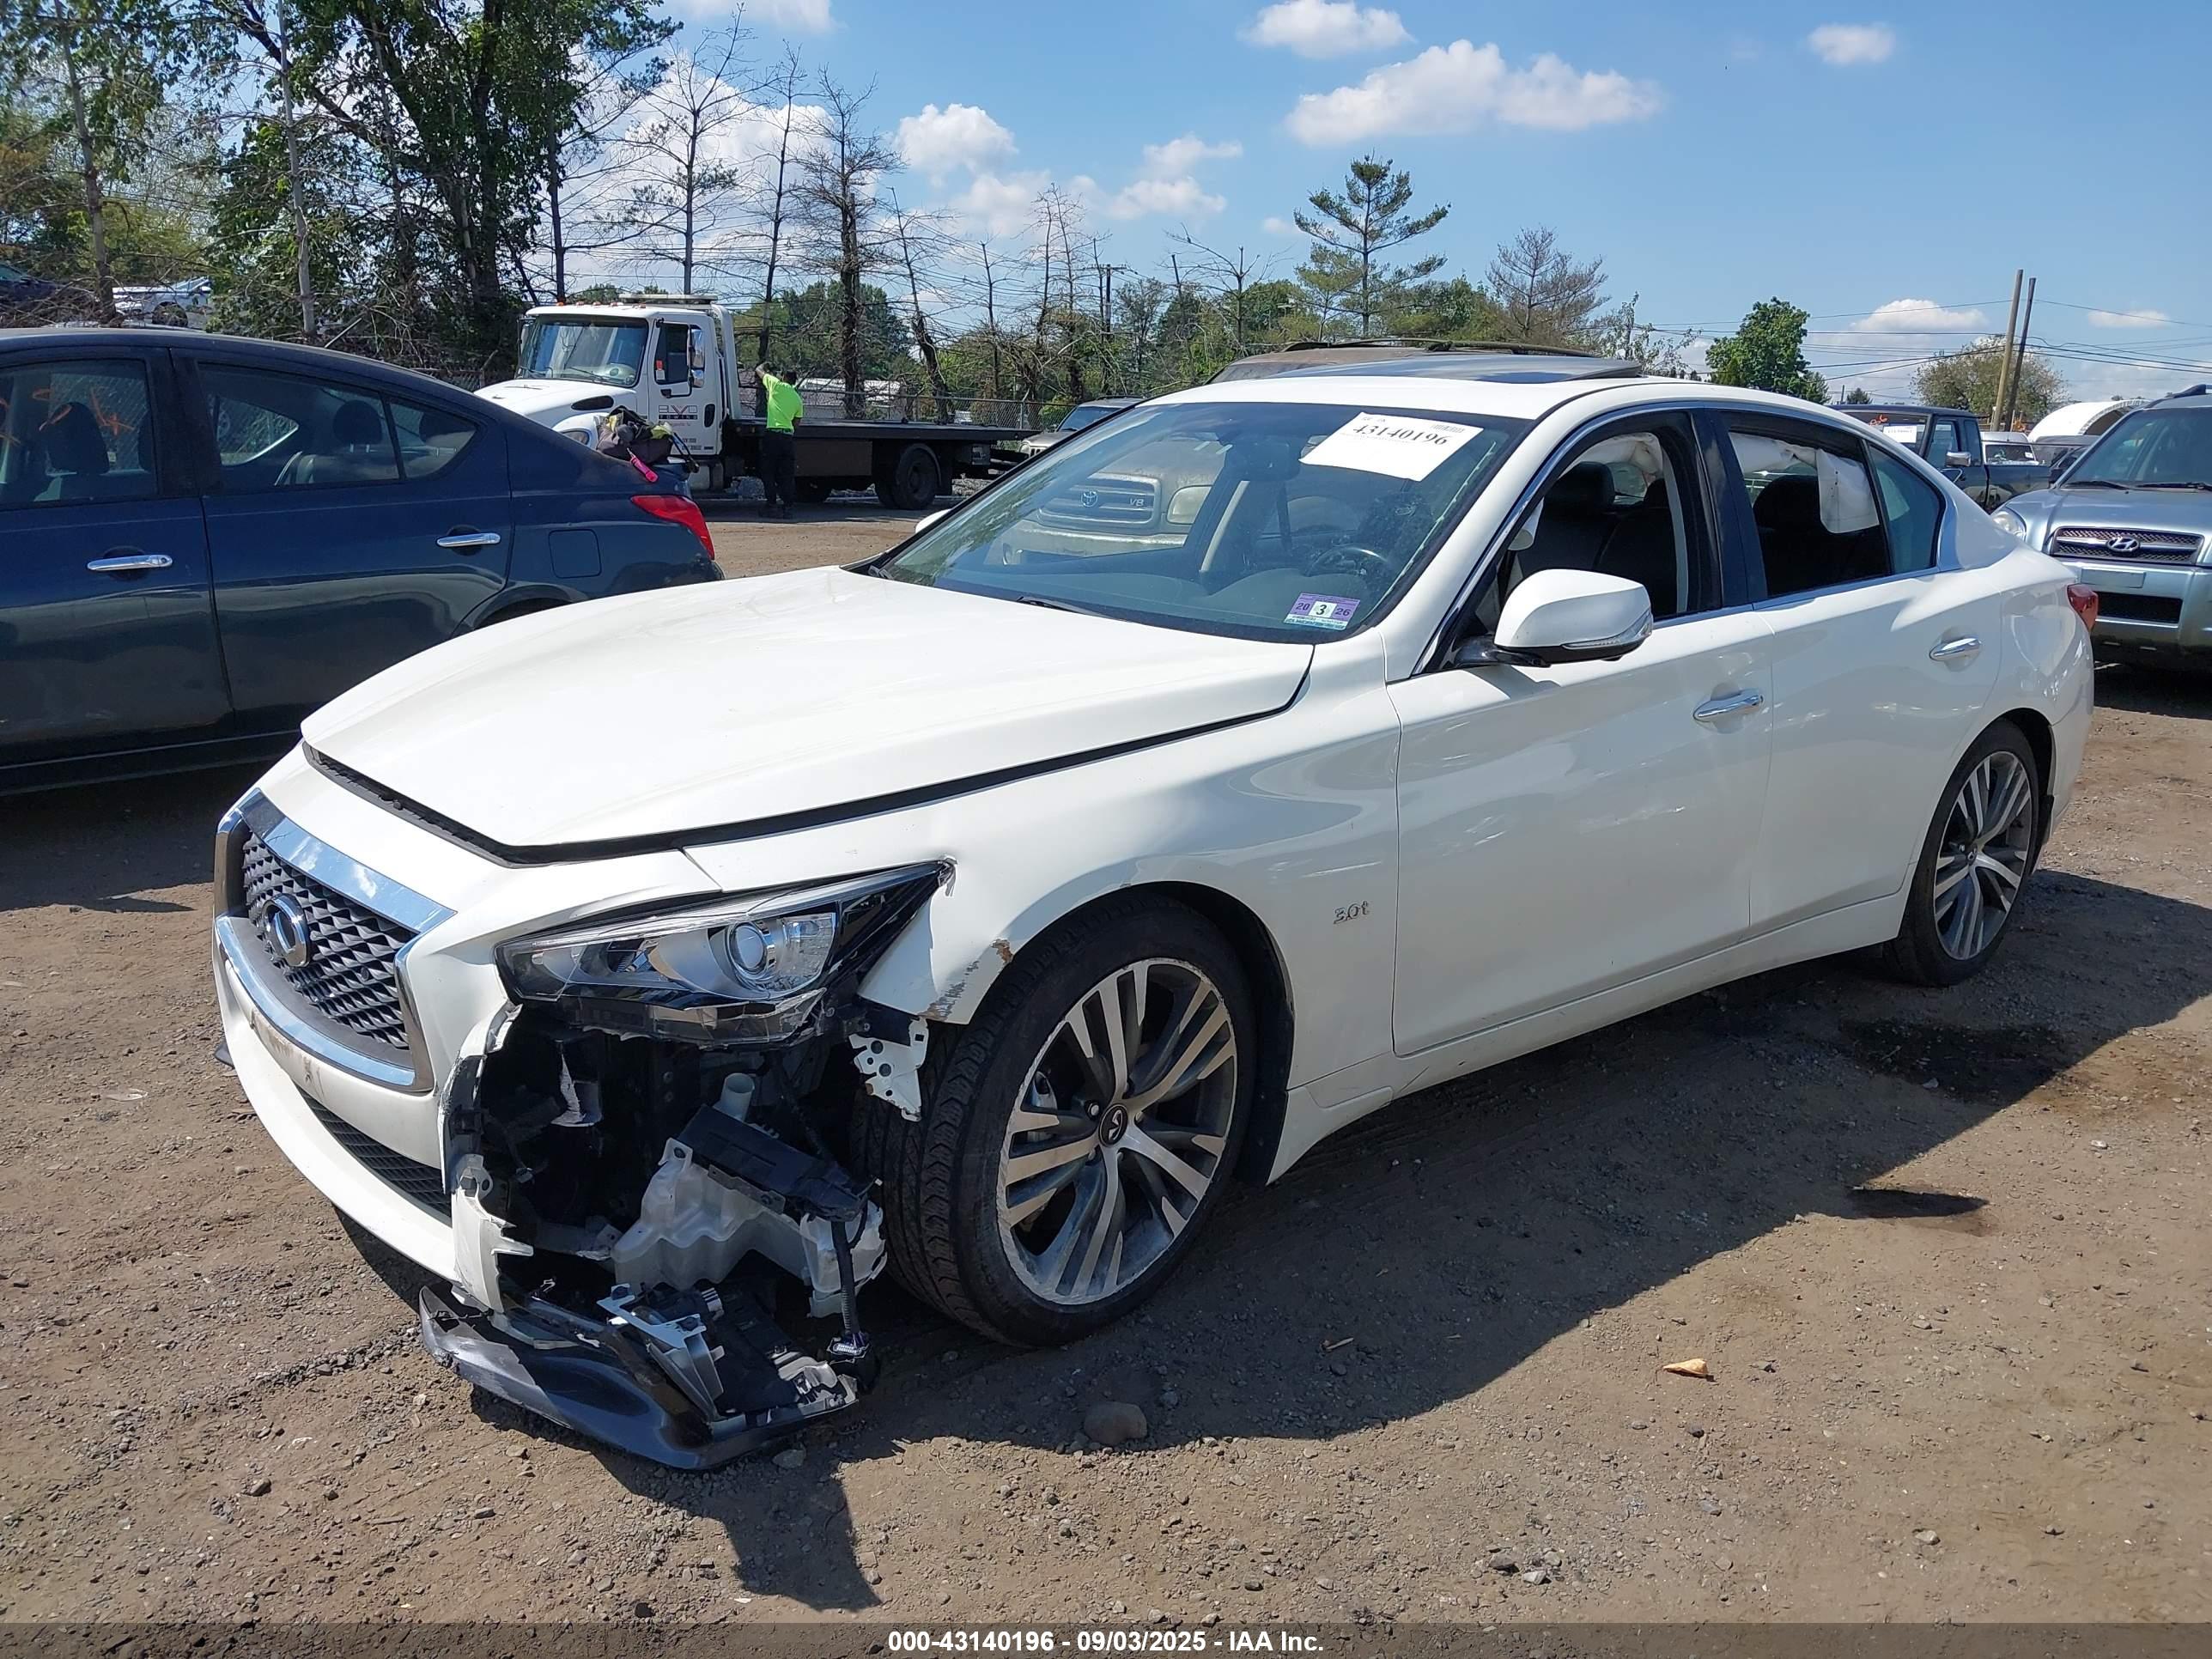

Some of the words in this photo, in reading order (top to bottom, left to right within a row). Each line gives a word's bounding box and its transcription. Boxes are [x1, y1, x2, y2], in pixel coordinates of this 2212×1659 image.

[659, 404, 697, 416] BLVD
[1352, 424, 1449, 445] 43140196
[1130, 498, 1144, 507] V8
[1296, 602, 1310, 611] 20
[1316, 604, 1328, 616] 3
[1334, 607, 1352, 617] 26
